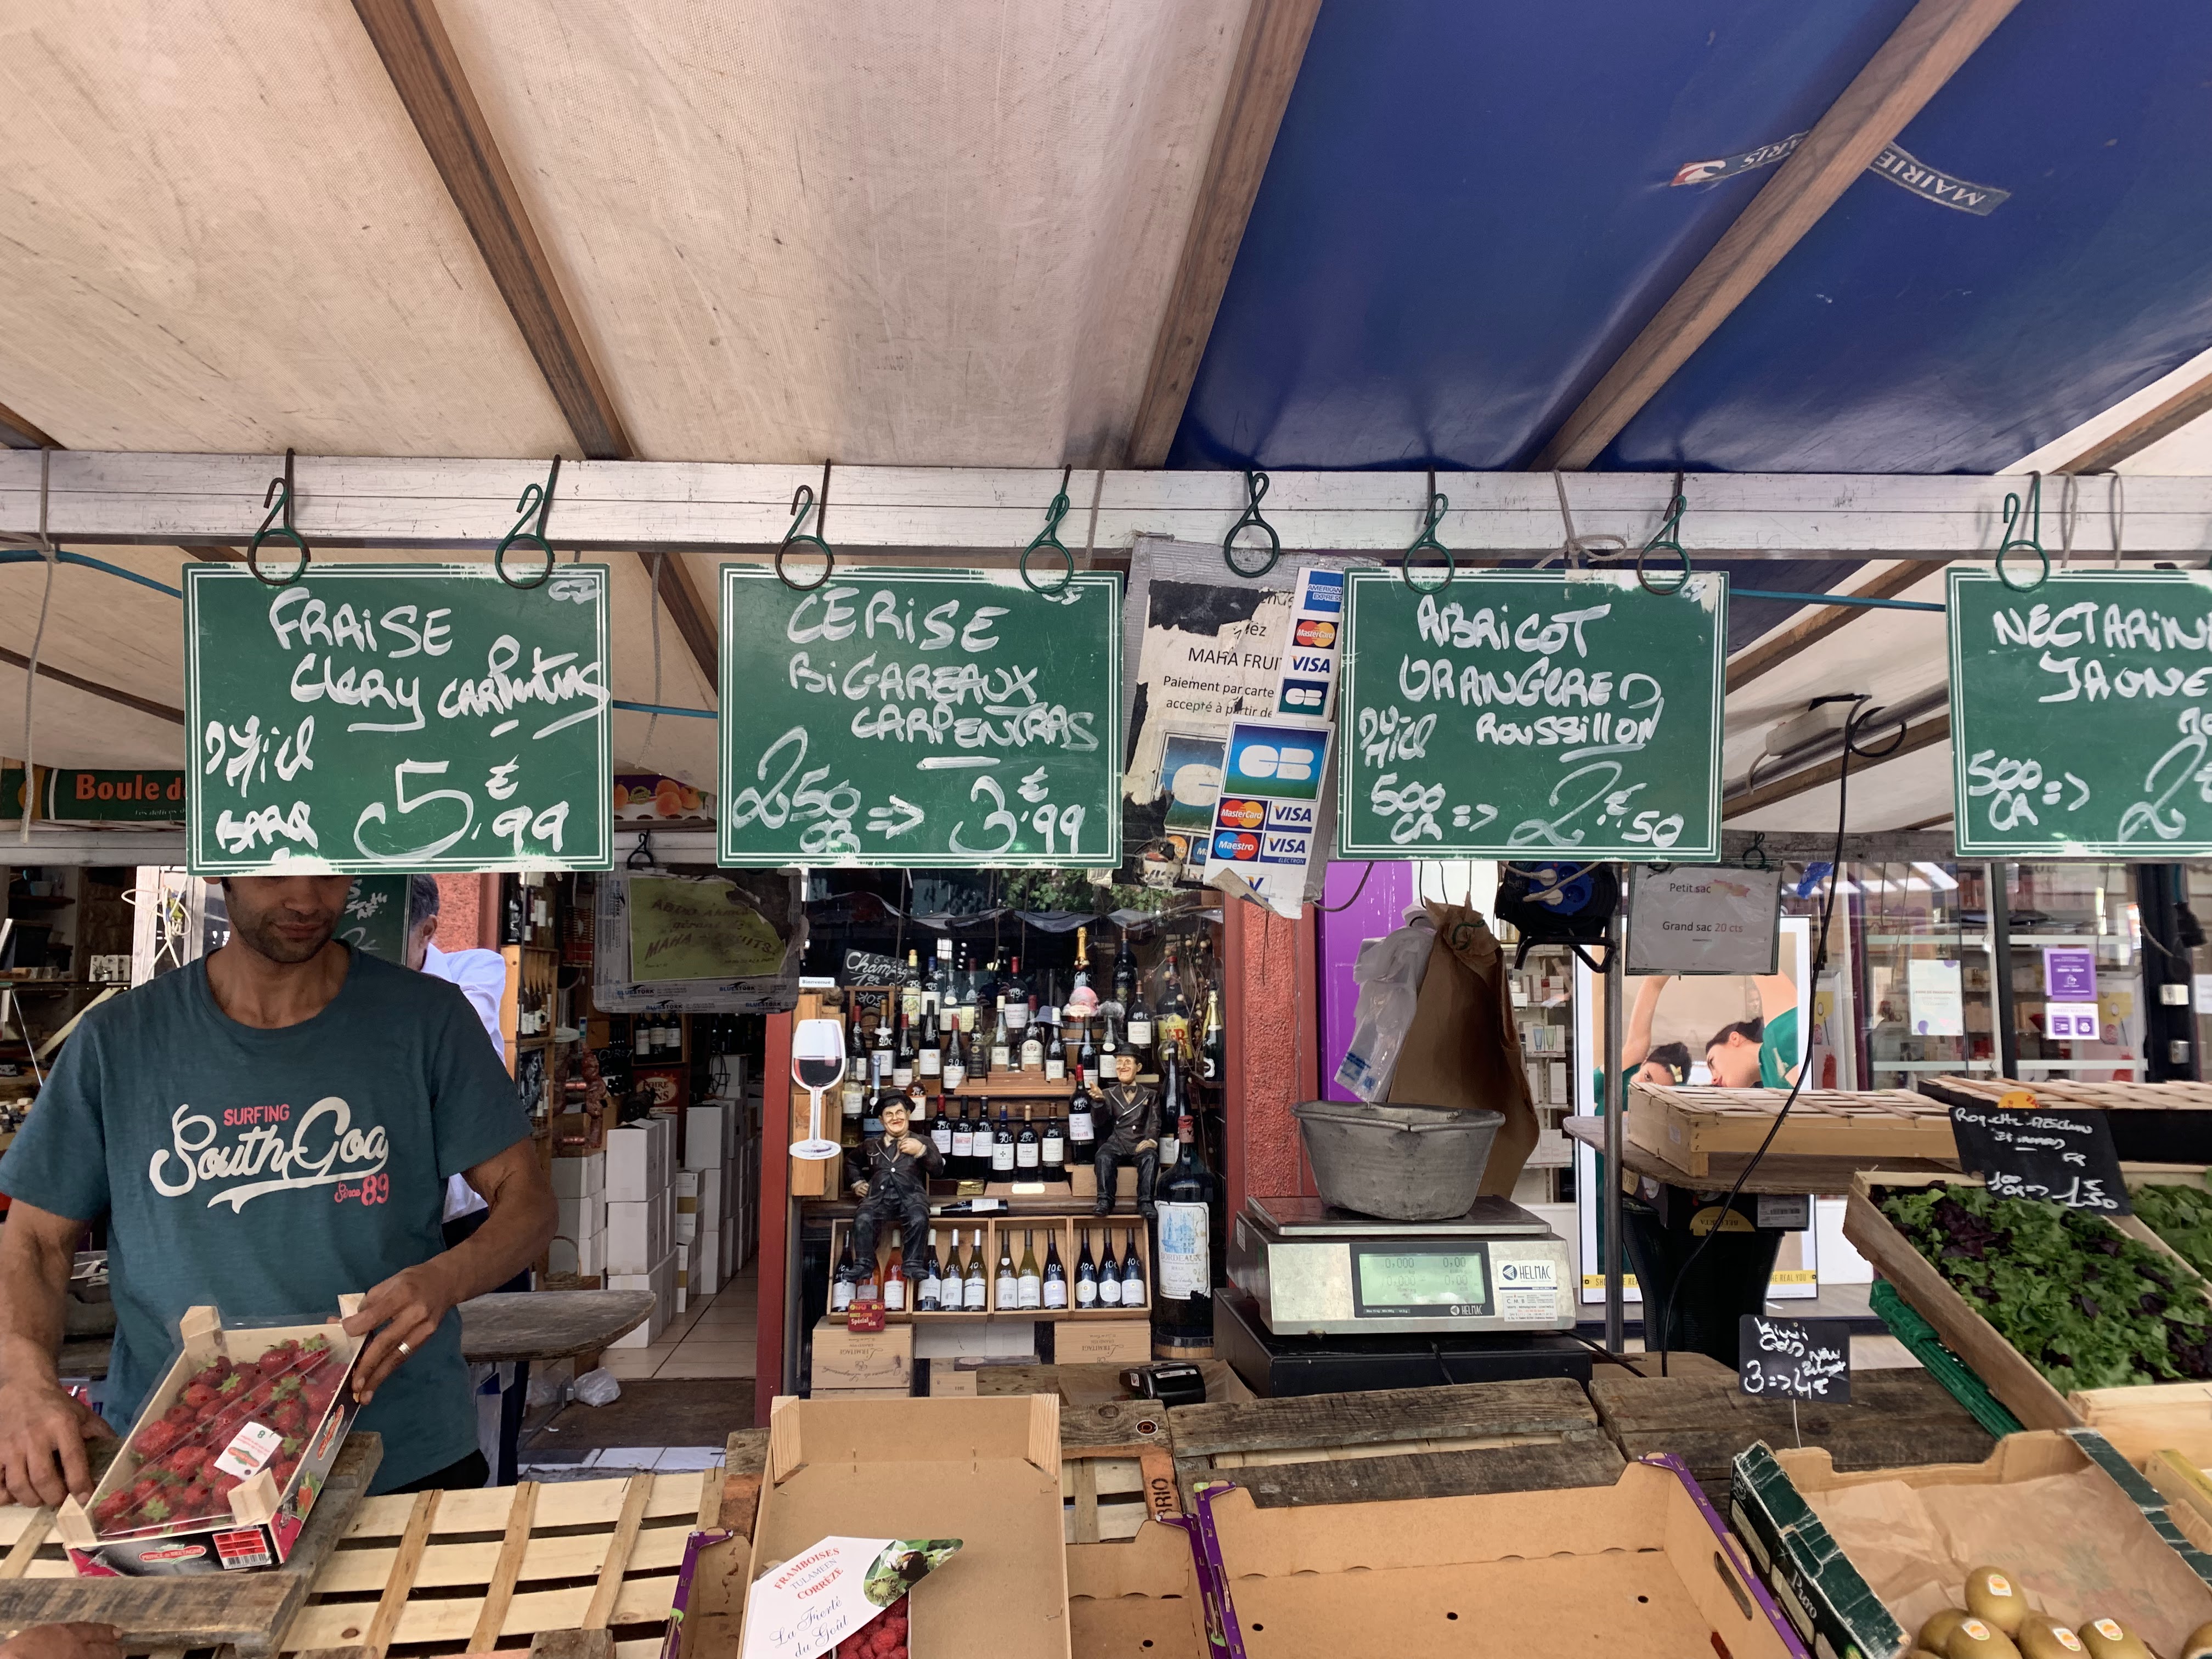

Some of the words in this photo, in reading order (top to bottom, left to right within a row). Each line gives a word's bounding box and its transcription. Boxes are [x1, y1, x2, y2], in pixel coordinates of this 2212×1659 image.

[1875, 151, 1987, 206] MAIRIE
[1307, 584, 1342, 594] AMERICAN
[1313, 593, 1342, 601] EXPRESS
[1297, 628, 1335, 640] MasterCard
[1188, 647, 1238, 667] MAHA
[1244, 653, 1282, 671] FRUI
[1292, 656, 1330, 673] VISA
[1164, 676, 1220, 692] Paiement
[1223, 685, 1243, 695] par
[1245, 686, 1274, 698] carte
[1166, 698, 1212, 713] accepté
[1216, 702, 1222, 713] à
[1226, 705, 1262, 716] prtir
[1968, 749, 2042, 797] 500
[76, 774, 160, 800] Boule
[1220, 808, 1262, 820] MasterCard
[1273, 805, 1312, 822] VISA
[1218, 840, 1254, 851] Maestro
[1267, 838, 1305, 854] VISA
[1669, 883, 1692, 893] Petit
[1695, 885, 1711, 894] sac
[1662, 921, 1693, 932] Grand
[1696, 923, 1712, 932] sac
[1715, 923, 1727, 932] 20
[1729, 924, 1743, 933] cts
[847, 951, 908, 984] Champag
[224, 1104, 290, 1126] SURFING
[149, 1104, 291, 1197] South
[335, 1182, 361, 1203] Since
[361, 1173, 390, 1206] 89
[1080, 1262, 1094, 1271] 10€
[1519, 1265, 1551, 1279] HELMAC
[1780, 1274, 1794, 1282] REAL
[1795, 1273, 1807, 1282] YOU
[1462, 1305, 1483, 1316] HELMAC
[851, 1317, 869, 1325] Spécial
[1744, 1360, 1765, 1393] 3
[774, 1547, 840, 1590] FRAMBOISES
[790, 1558, 838, 1590] TULAMEEN
[797, 1567, 844, 1600] CORRÈZE
[769, 1627, 797, 1649] La
[797, 1596, 843, 1632] Fierté
[794, 1641, 812, 1658] du
[811, 1615, 849, 1647] Goût
